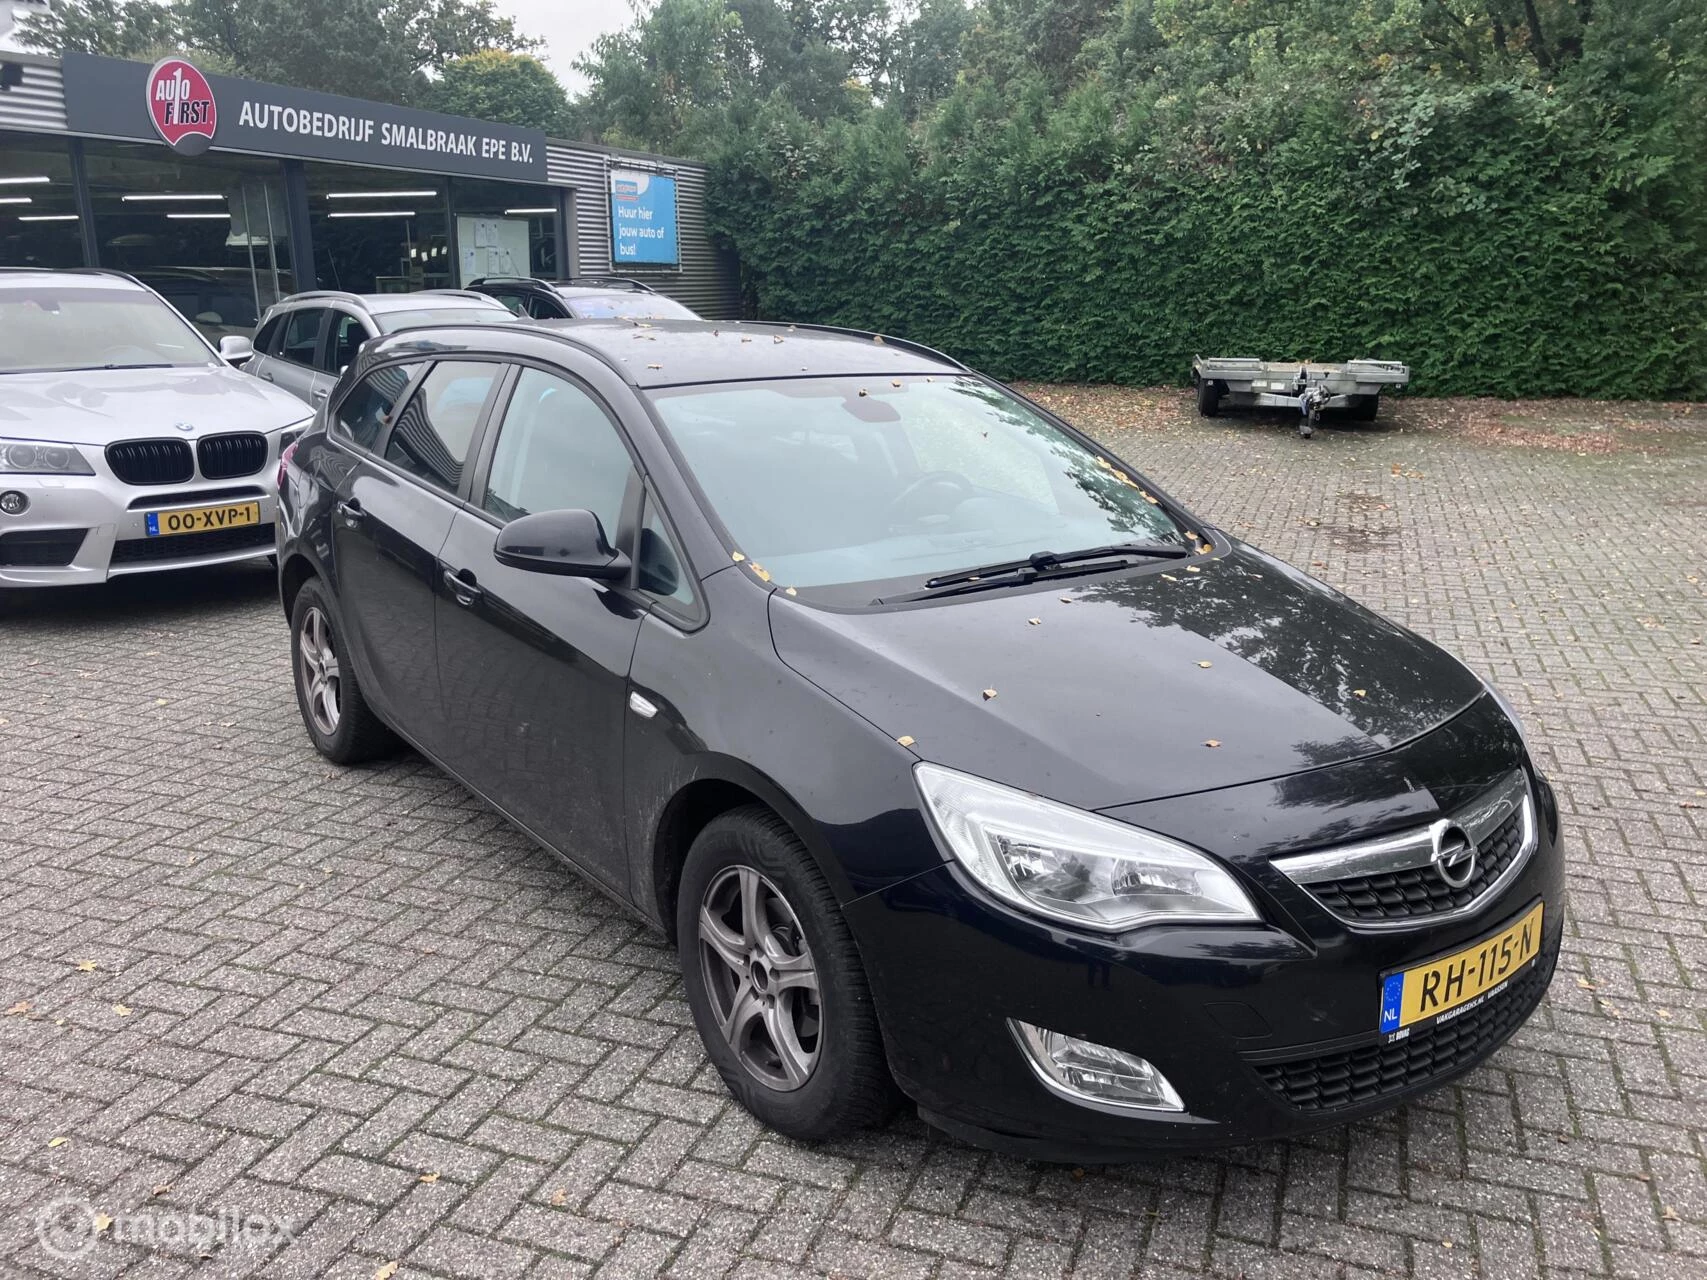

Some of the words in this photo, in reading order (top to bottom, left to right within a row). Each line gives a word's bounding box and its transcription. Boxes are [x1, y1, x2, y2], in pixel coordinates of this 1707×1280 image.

[239, 101, 374, 142] AUTOBEDRIJF
[381, 122, 476, 156] SMALBRAAK
[482, 138, 506, 160] EPE
[511, 141, 533, 163] B.V.
[618, 206, 637, 218] Huur
[638, 206, 653, 220] hier
[618, 224, 638, 239] jouw
[639, 228, 656, 238] auto
[657, 227, 664, 239] of
[620, 242, 636, 256] bus!
[168, 506, 250, 531] 00-XVP-1
[1420, 917, 1534, 1012] RH-115-N
[1383, 1007, 1398, 1023] NL
